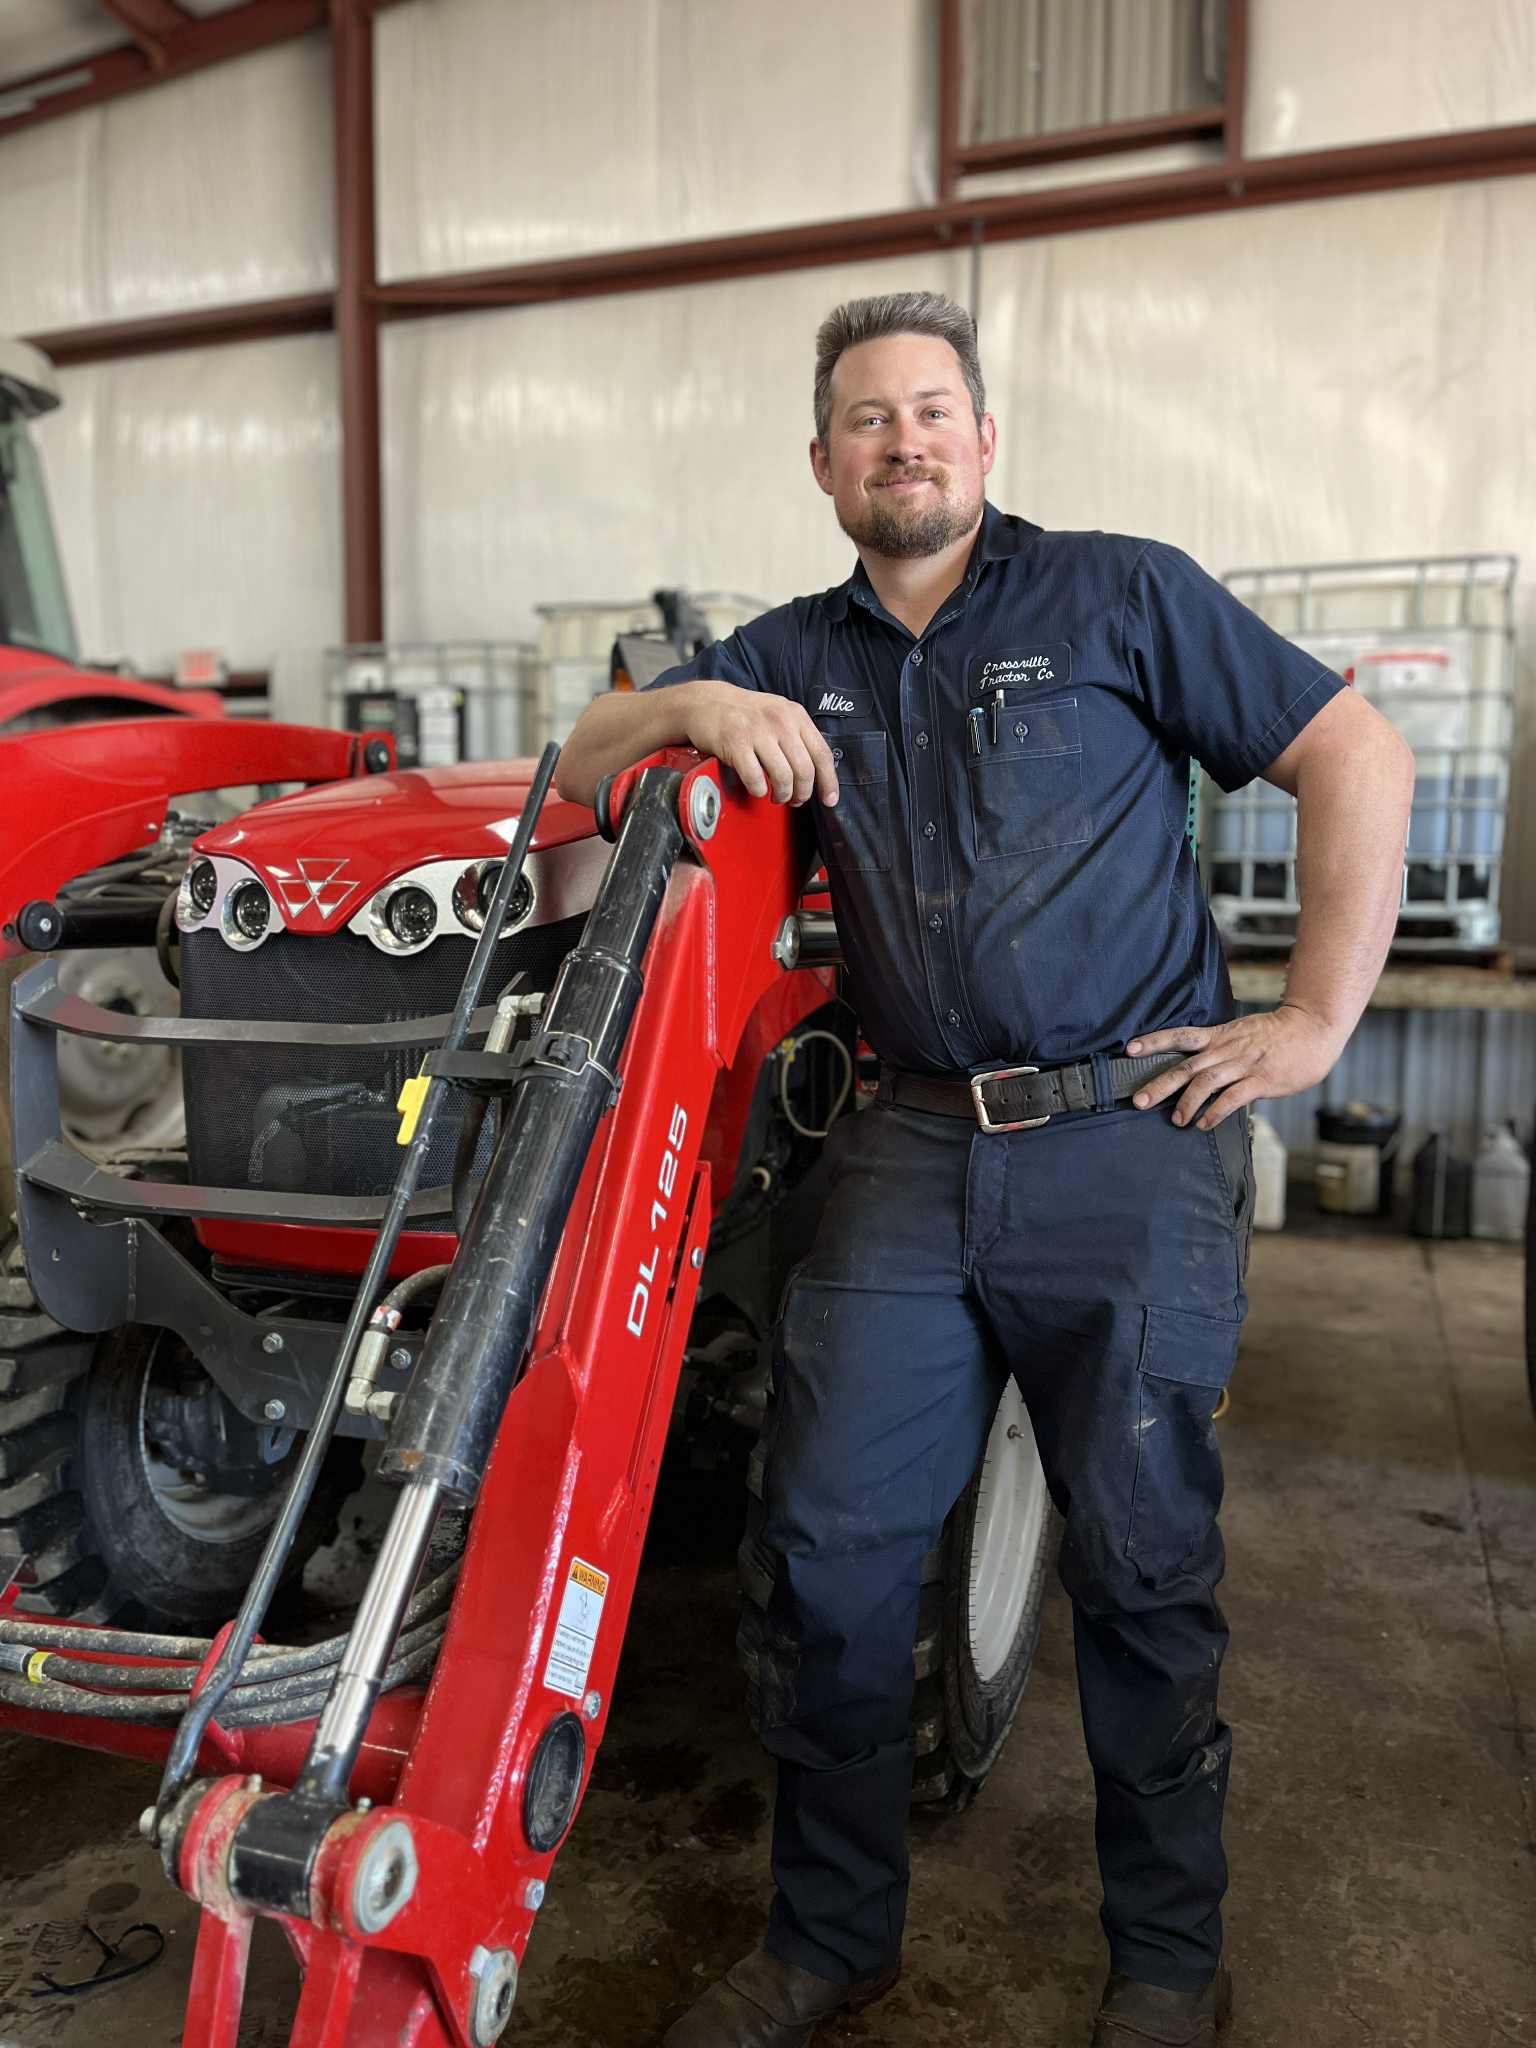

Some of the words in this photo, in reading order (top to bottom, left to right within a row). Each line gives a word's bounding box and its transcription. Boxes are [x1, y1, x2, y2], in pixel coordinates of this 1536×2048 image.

[983, 655, 1051, 675] Crossville
[980, 671, 1030, 690] Tractor
[1037, 668, 1055, 680] Co
[818, 692, 855, 711] Mike
[626, 1247, 659, 1338] DL
[650, 1103, 688, 1232] 125
[578, 1570, 606, 1594] WARNING
